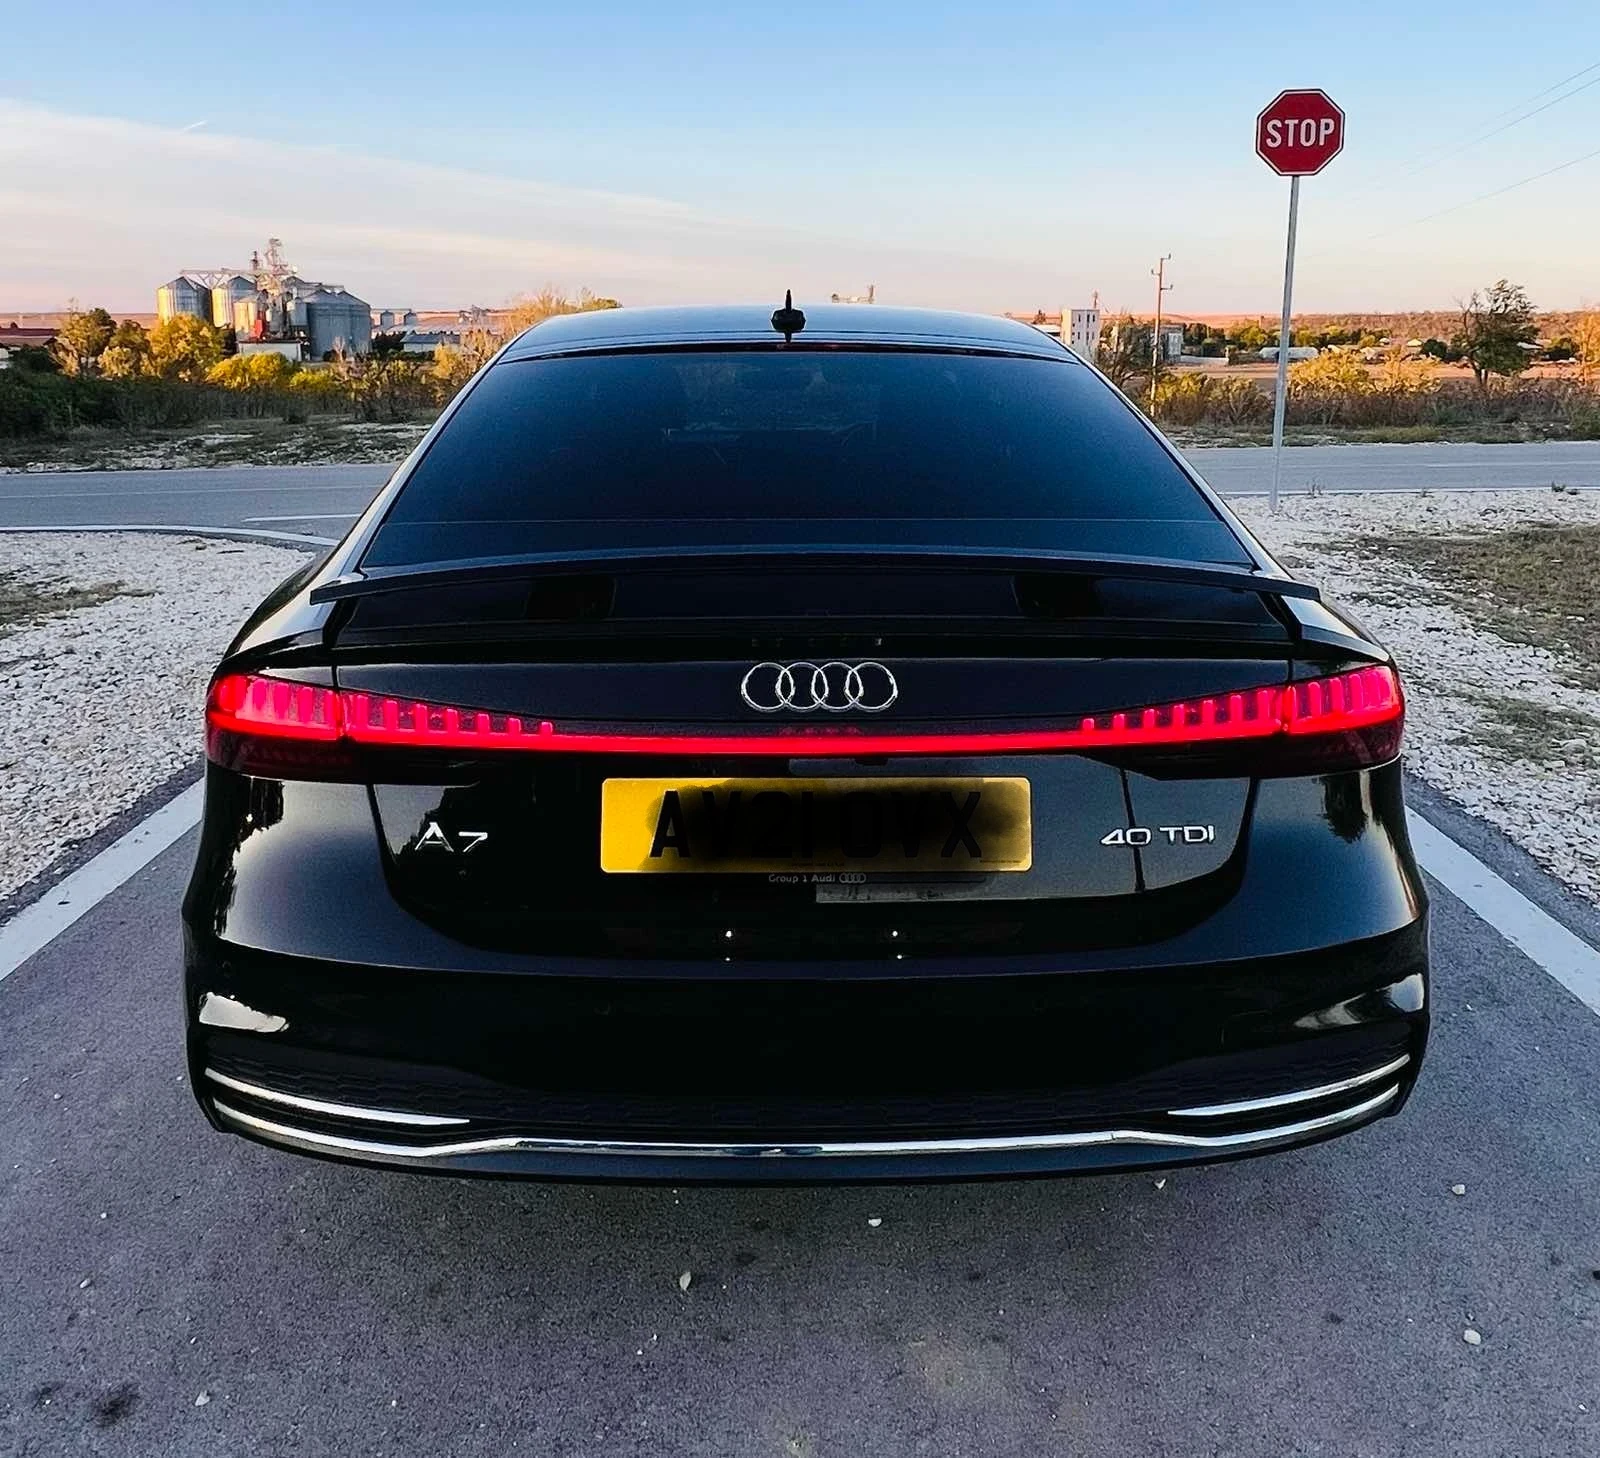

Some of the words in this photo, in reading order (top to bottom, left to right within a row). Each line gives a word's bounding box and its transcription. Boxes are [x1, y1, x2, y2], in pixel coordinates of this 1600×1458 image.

[1266, 118, 1335, 148] STOP
[414, 822, 489, 853] A7
[1100, 827, 1152, 845] 40
[1159, 825, 1215, 843] TDI
[768, 874, 799, 884] Group
[811, 874, 836, 883] Audi
